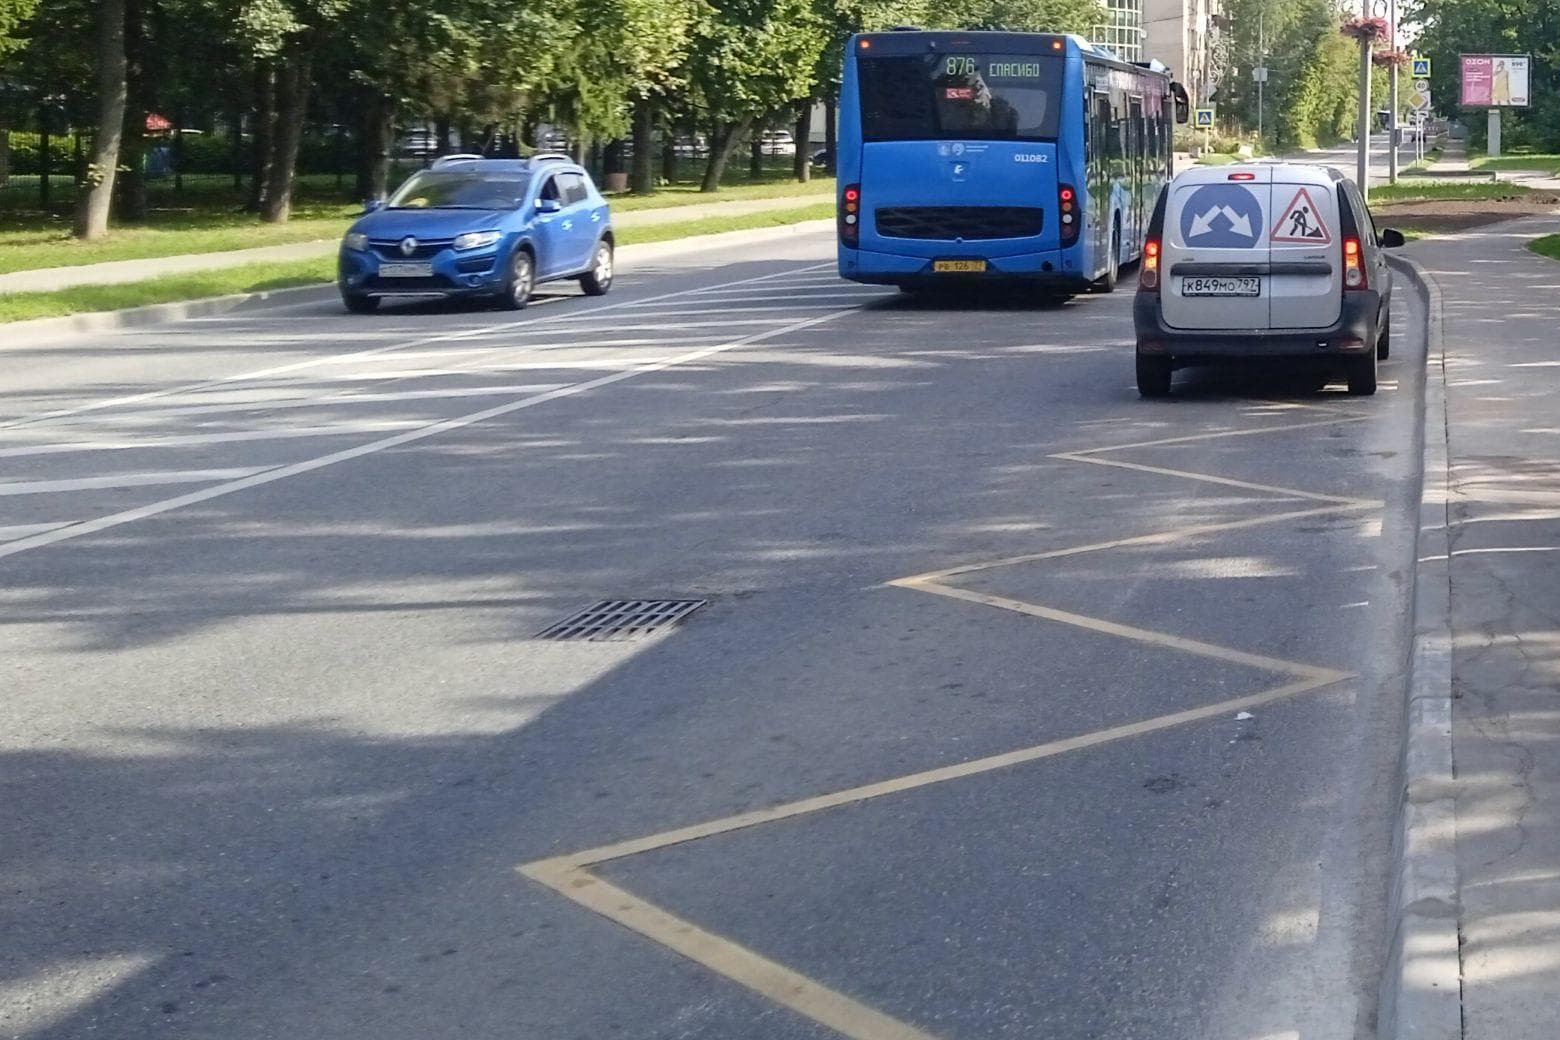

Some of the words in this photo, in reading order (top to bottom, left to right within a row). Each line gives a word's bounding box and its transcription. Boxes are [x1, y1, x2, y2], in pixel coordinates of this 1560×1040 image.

[946, 57, 975, 76] 876
[989, 63, 1040, 77] СПАСИБО
[1014, 154, 1049, 163] 011082
